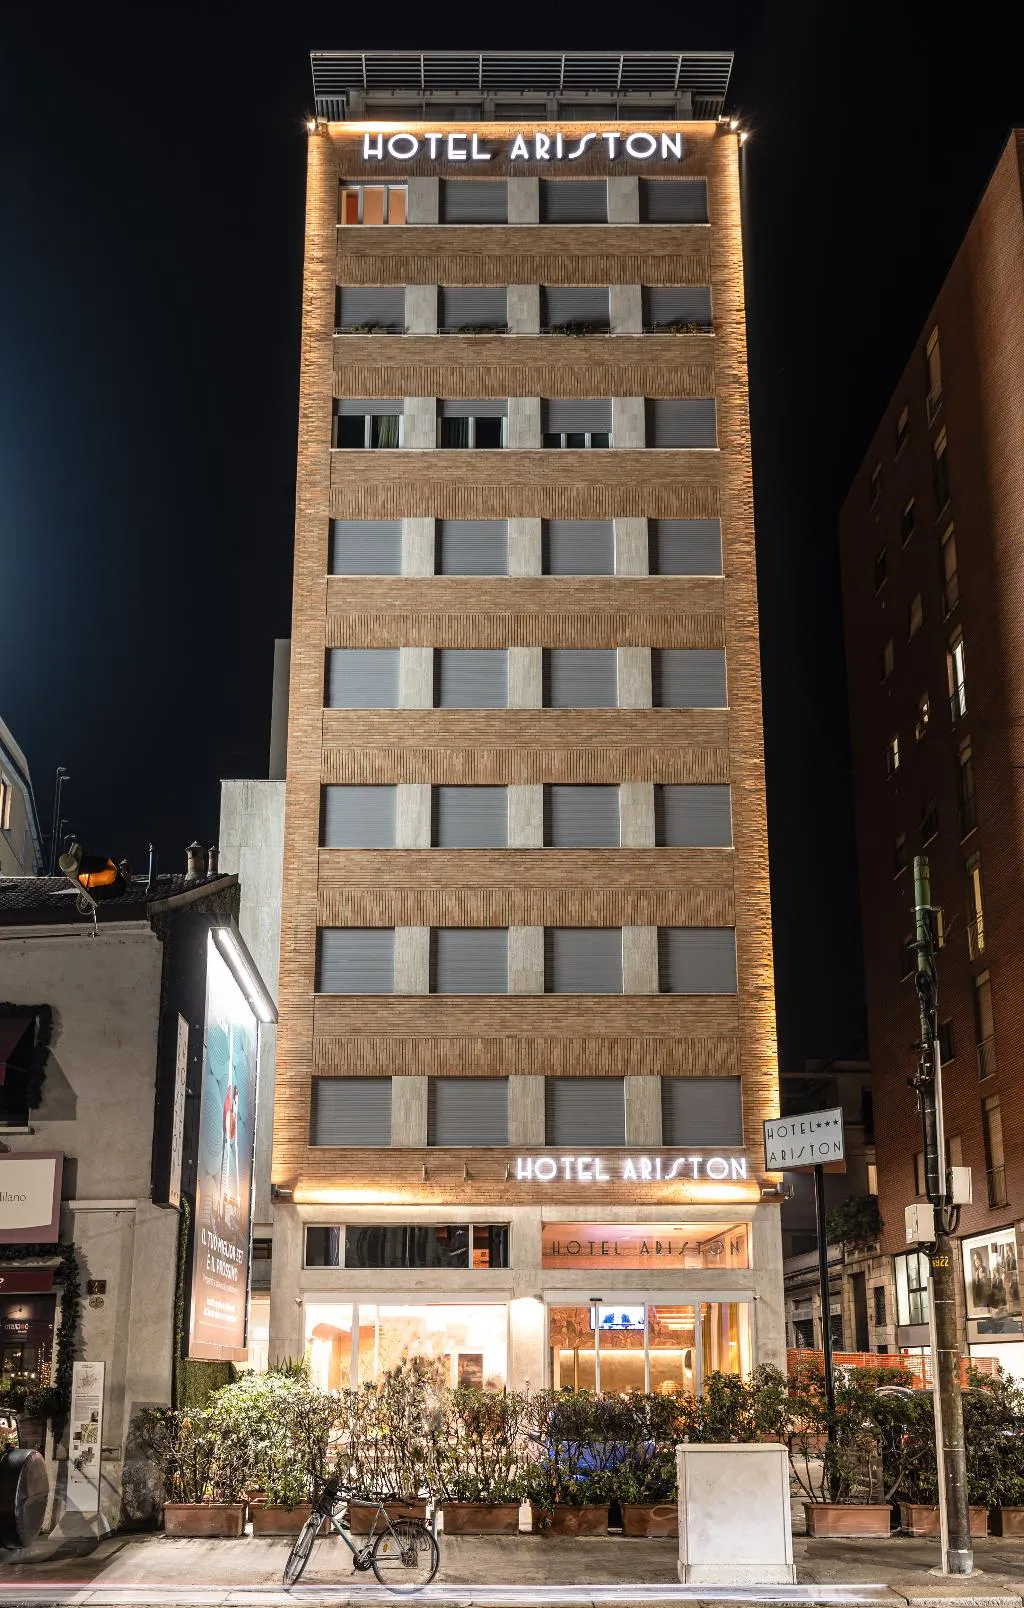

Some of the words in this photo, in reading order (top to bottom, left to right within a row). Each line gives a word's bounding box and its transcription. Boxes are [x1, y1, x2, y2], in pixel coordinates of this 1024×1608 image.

[363, 132, 491, 160] HOTEL
[510, 132, 682, 160] ARISTON
[769, 1141, 841, 1162] ARISTON
[516, 1157, 609, 1180] HOTEL
[623, 1157, 748, 1180] ARISTON
[0, 1191, 27, 1202] ilano
[552, 1240, 621, 1255] HOTEL
[638, 1240, 740, 1255] ARISTON
